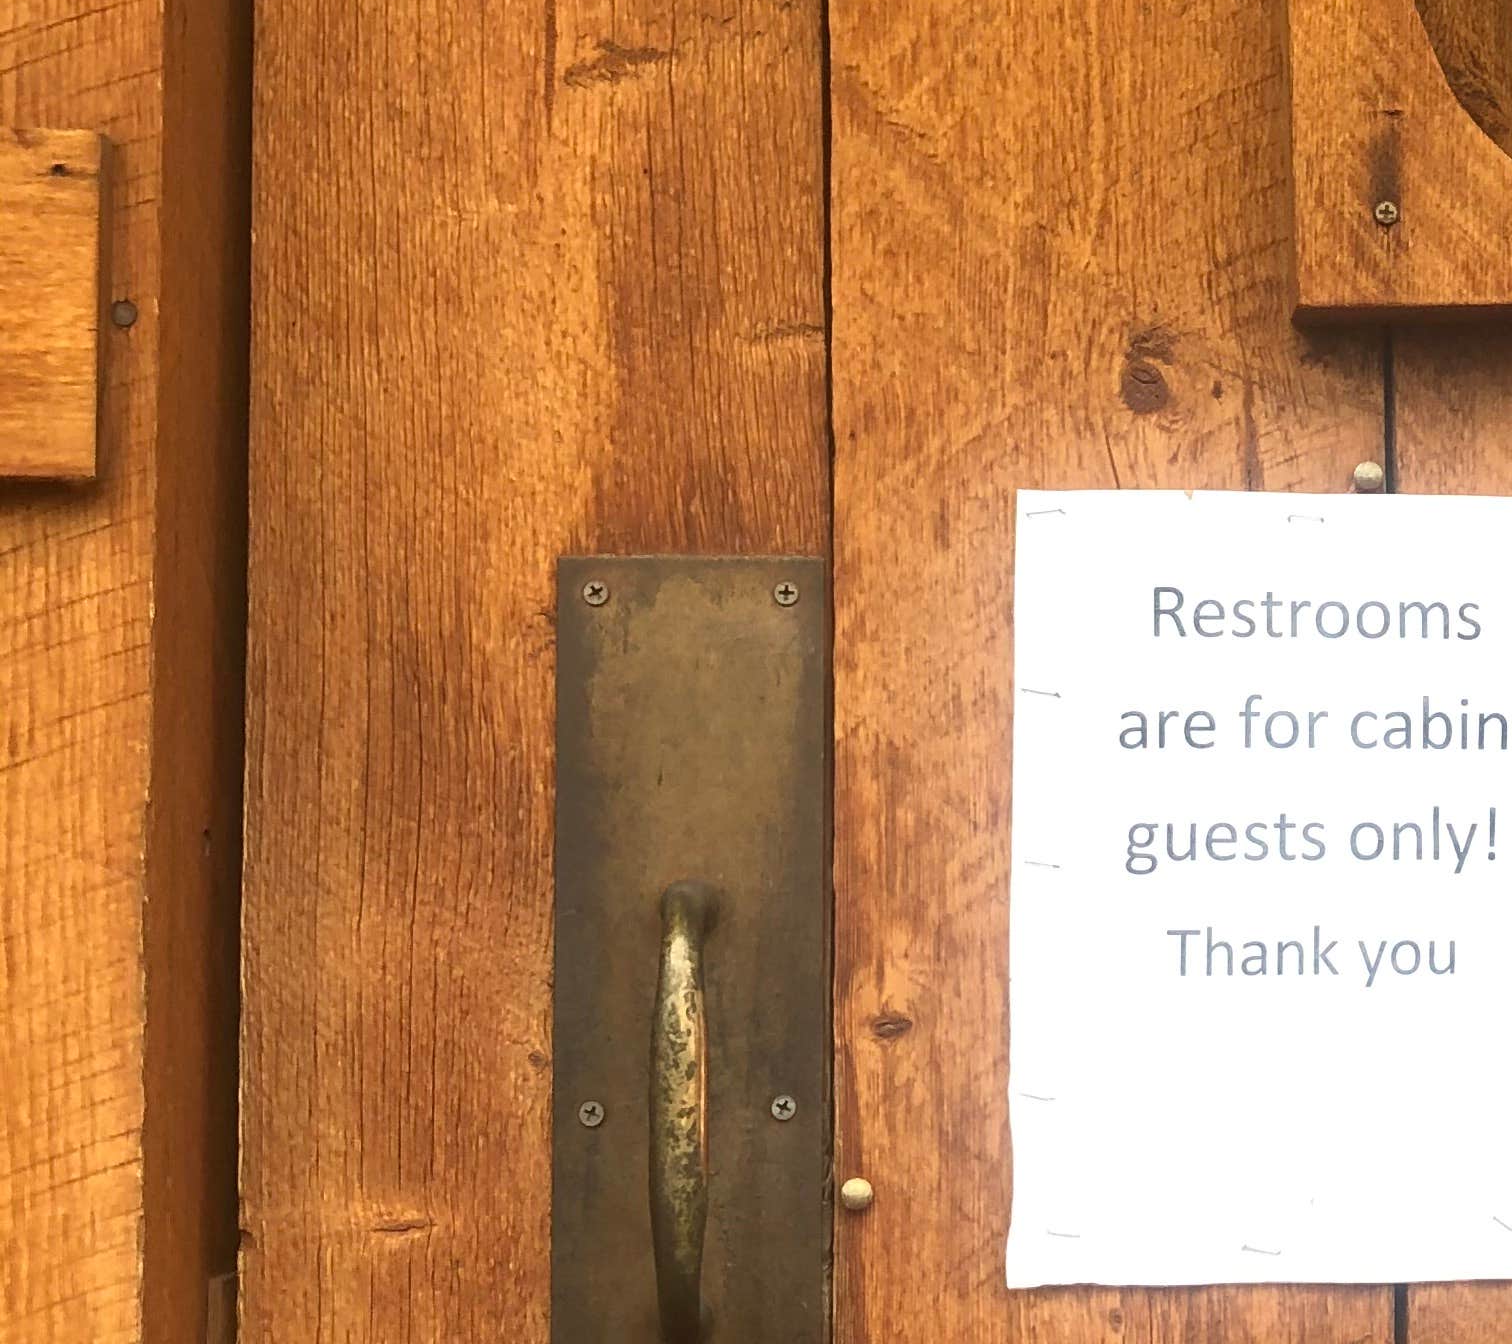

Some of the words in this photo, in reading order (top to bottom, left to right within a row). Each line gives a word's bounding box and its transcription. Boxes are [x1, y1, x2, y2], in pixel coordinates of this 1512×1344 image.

[1152, 586, 1482, 641] Restrooms
[1118, 705, 1216, 750] are
[1239, 694, 1329, 749] for
[1350, 696, 1509, 751] cabin
[1125, 812, 1327, 875] guests
[1350, 806, 1498, 875] only!
[1166, 925, 1339, 977] Thank
[1358, 937, 1457, 988] you
